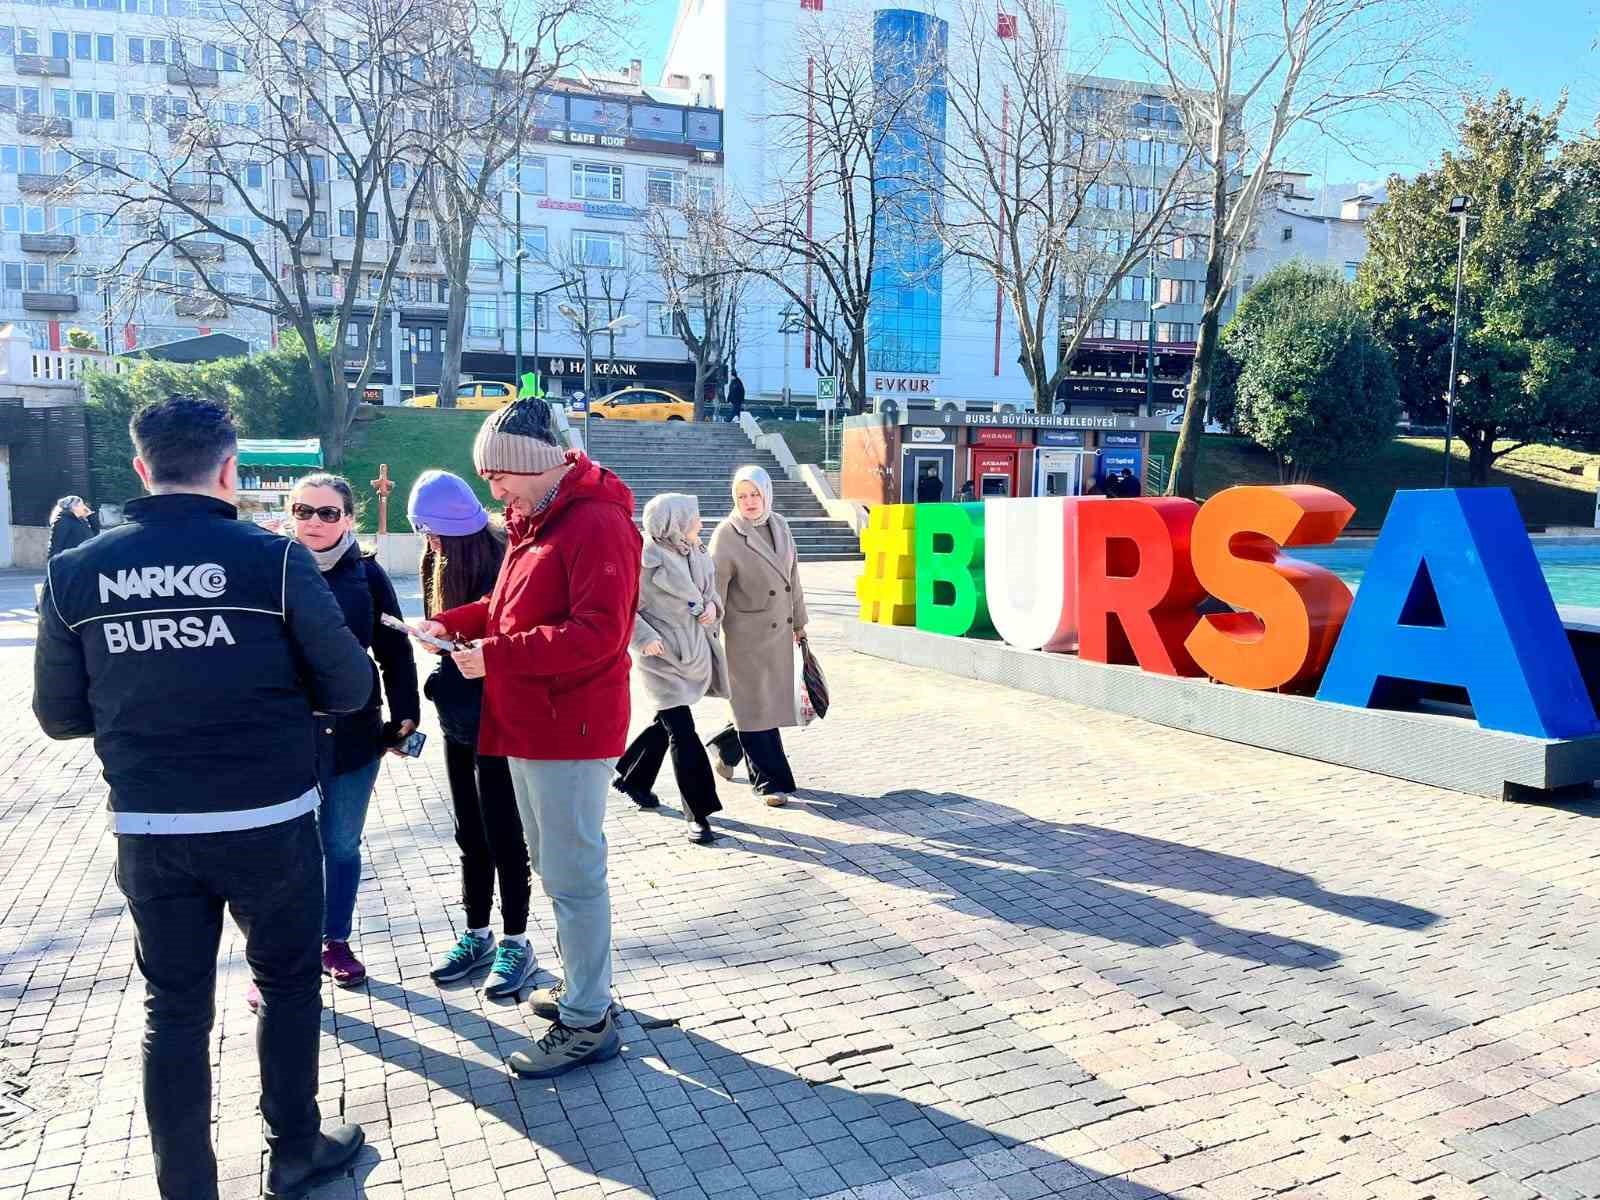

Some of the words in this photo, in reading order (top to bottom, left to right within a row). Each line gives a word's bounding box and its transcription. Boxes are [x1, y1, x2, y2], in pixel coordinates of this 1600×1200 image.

[570, 132, 596, 145] CAFE
[600, 135, 626, 146] ROOF
[570, 361, 637, 376] HAKBANK
[875, 377, 930, 393] EVKUR
[965, 414, 998, 425] BURSA
[103, 614, 236, 653] BURSA
